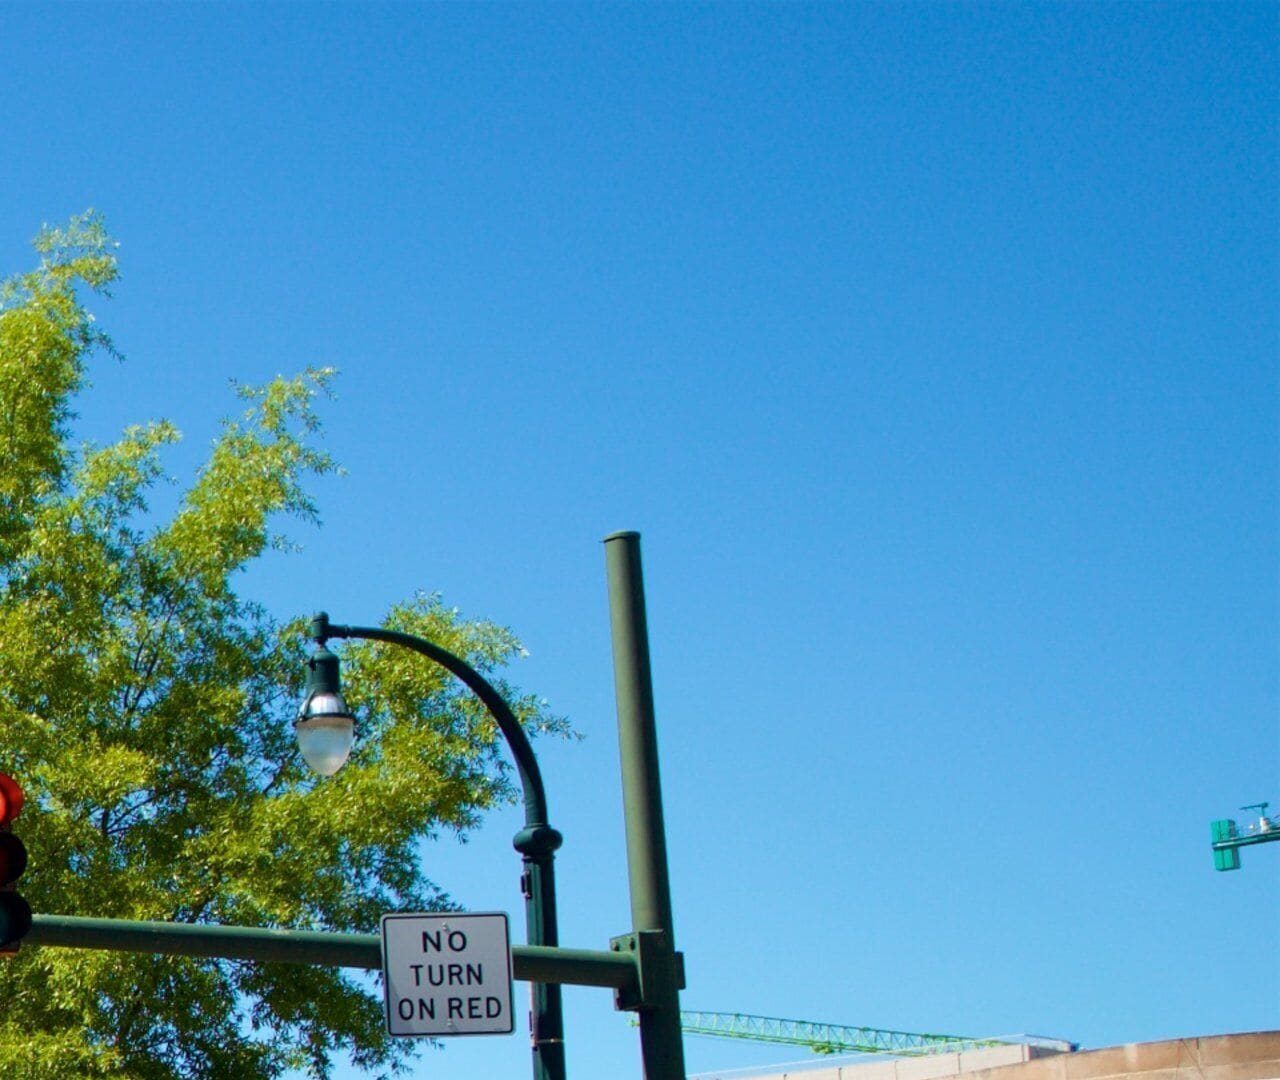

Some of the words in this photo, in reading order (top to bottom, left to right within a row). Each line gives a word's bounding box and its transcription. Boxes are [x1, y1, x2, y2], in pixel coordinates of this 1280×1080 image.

[422, 930, 467, 952] NO
[410, 963, 483, 986] TURN
[398, 998, 435, 1021] ON
[448, 997, 502, 1019] RED
